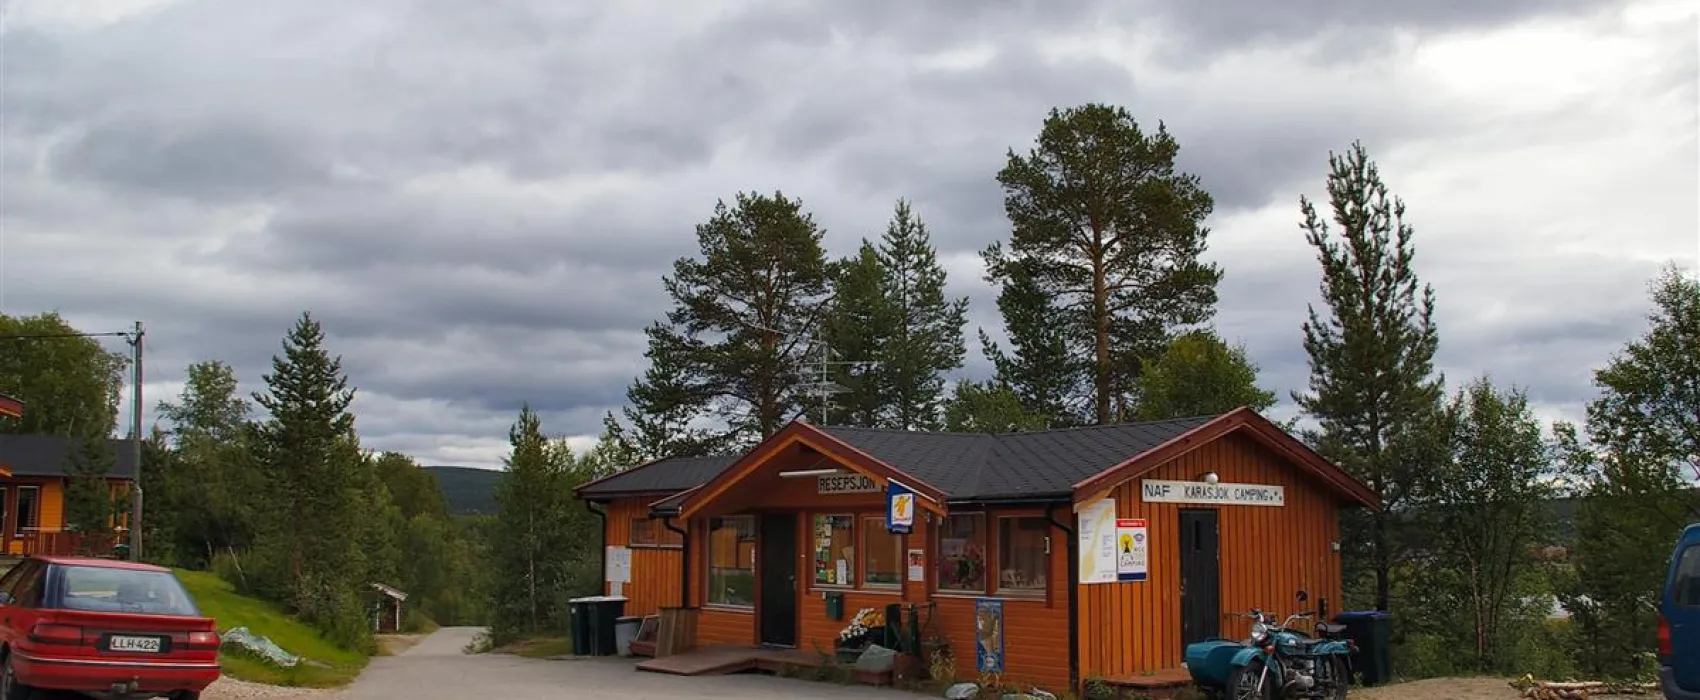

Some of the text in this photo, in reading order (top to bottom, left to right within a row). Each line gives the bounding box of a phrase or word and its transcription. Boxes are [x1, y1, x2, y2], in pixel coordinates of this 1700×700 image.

[820, 476, 875, 491] RESEPSJON
[1144, 484, 1269, 501] NAF KARASJOK CAMPING
